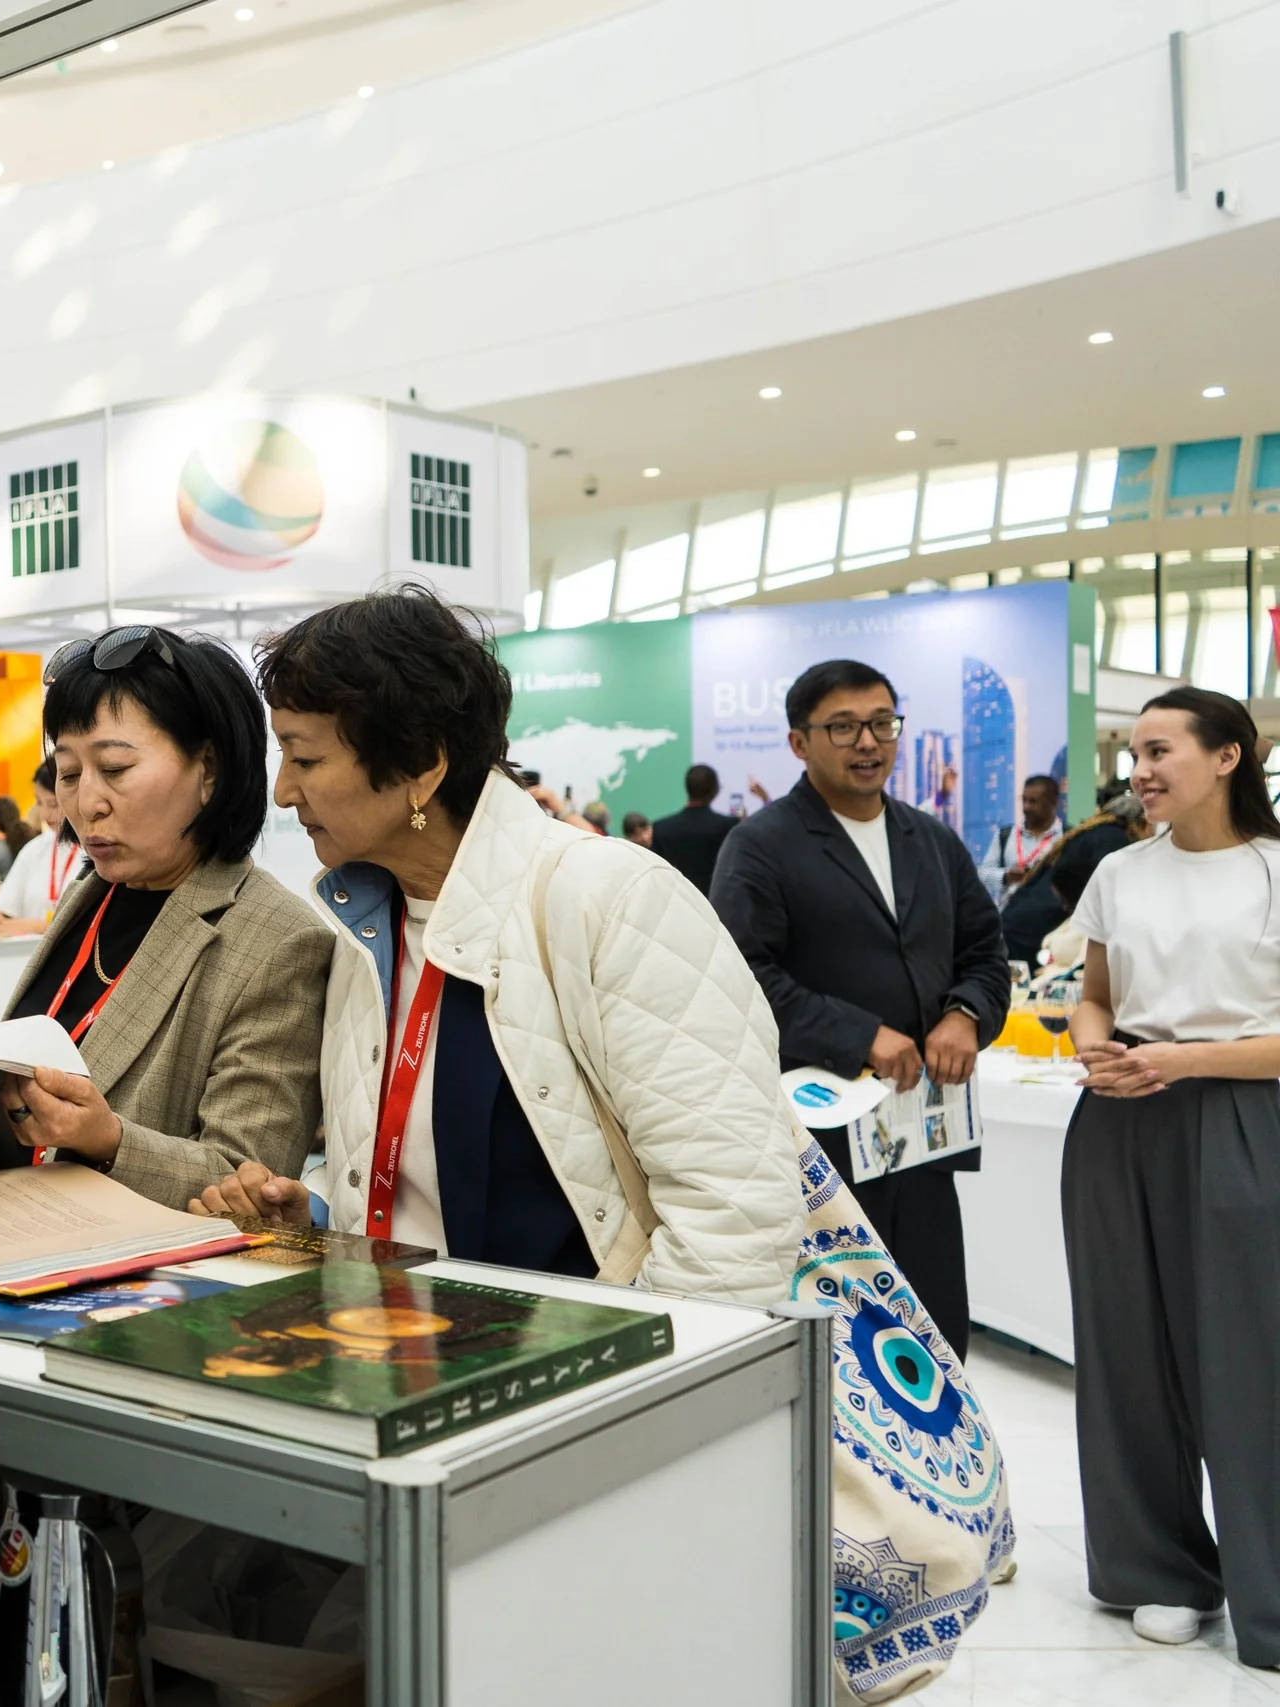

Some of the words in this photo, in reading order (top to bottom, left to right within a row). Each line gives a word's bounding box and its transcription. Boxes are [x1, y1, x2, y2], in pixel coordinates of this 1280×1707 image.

[11, 494, 66, 522] IFLA
[412, 484, 461, 510] IFLA
[714, 677, 795, 718] BUS
[415, 1011, 430, 1049] ZEUTSCHEL
[387, 1135, 399, 1172] ZEUTSCHEL
[396, 1344, 618, 1440] FURUSIYYA
